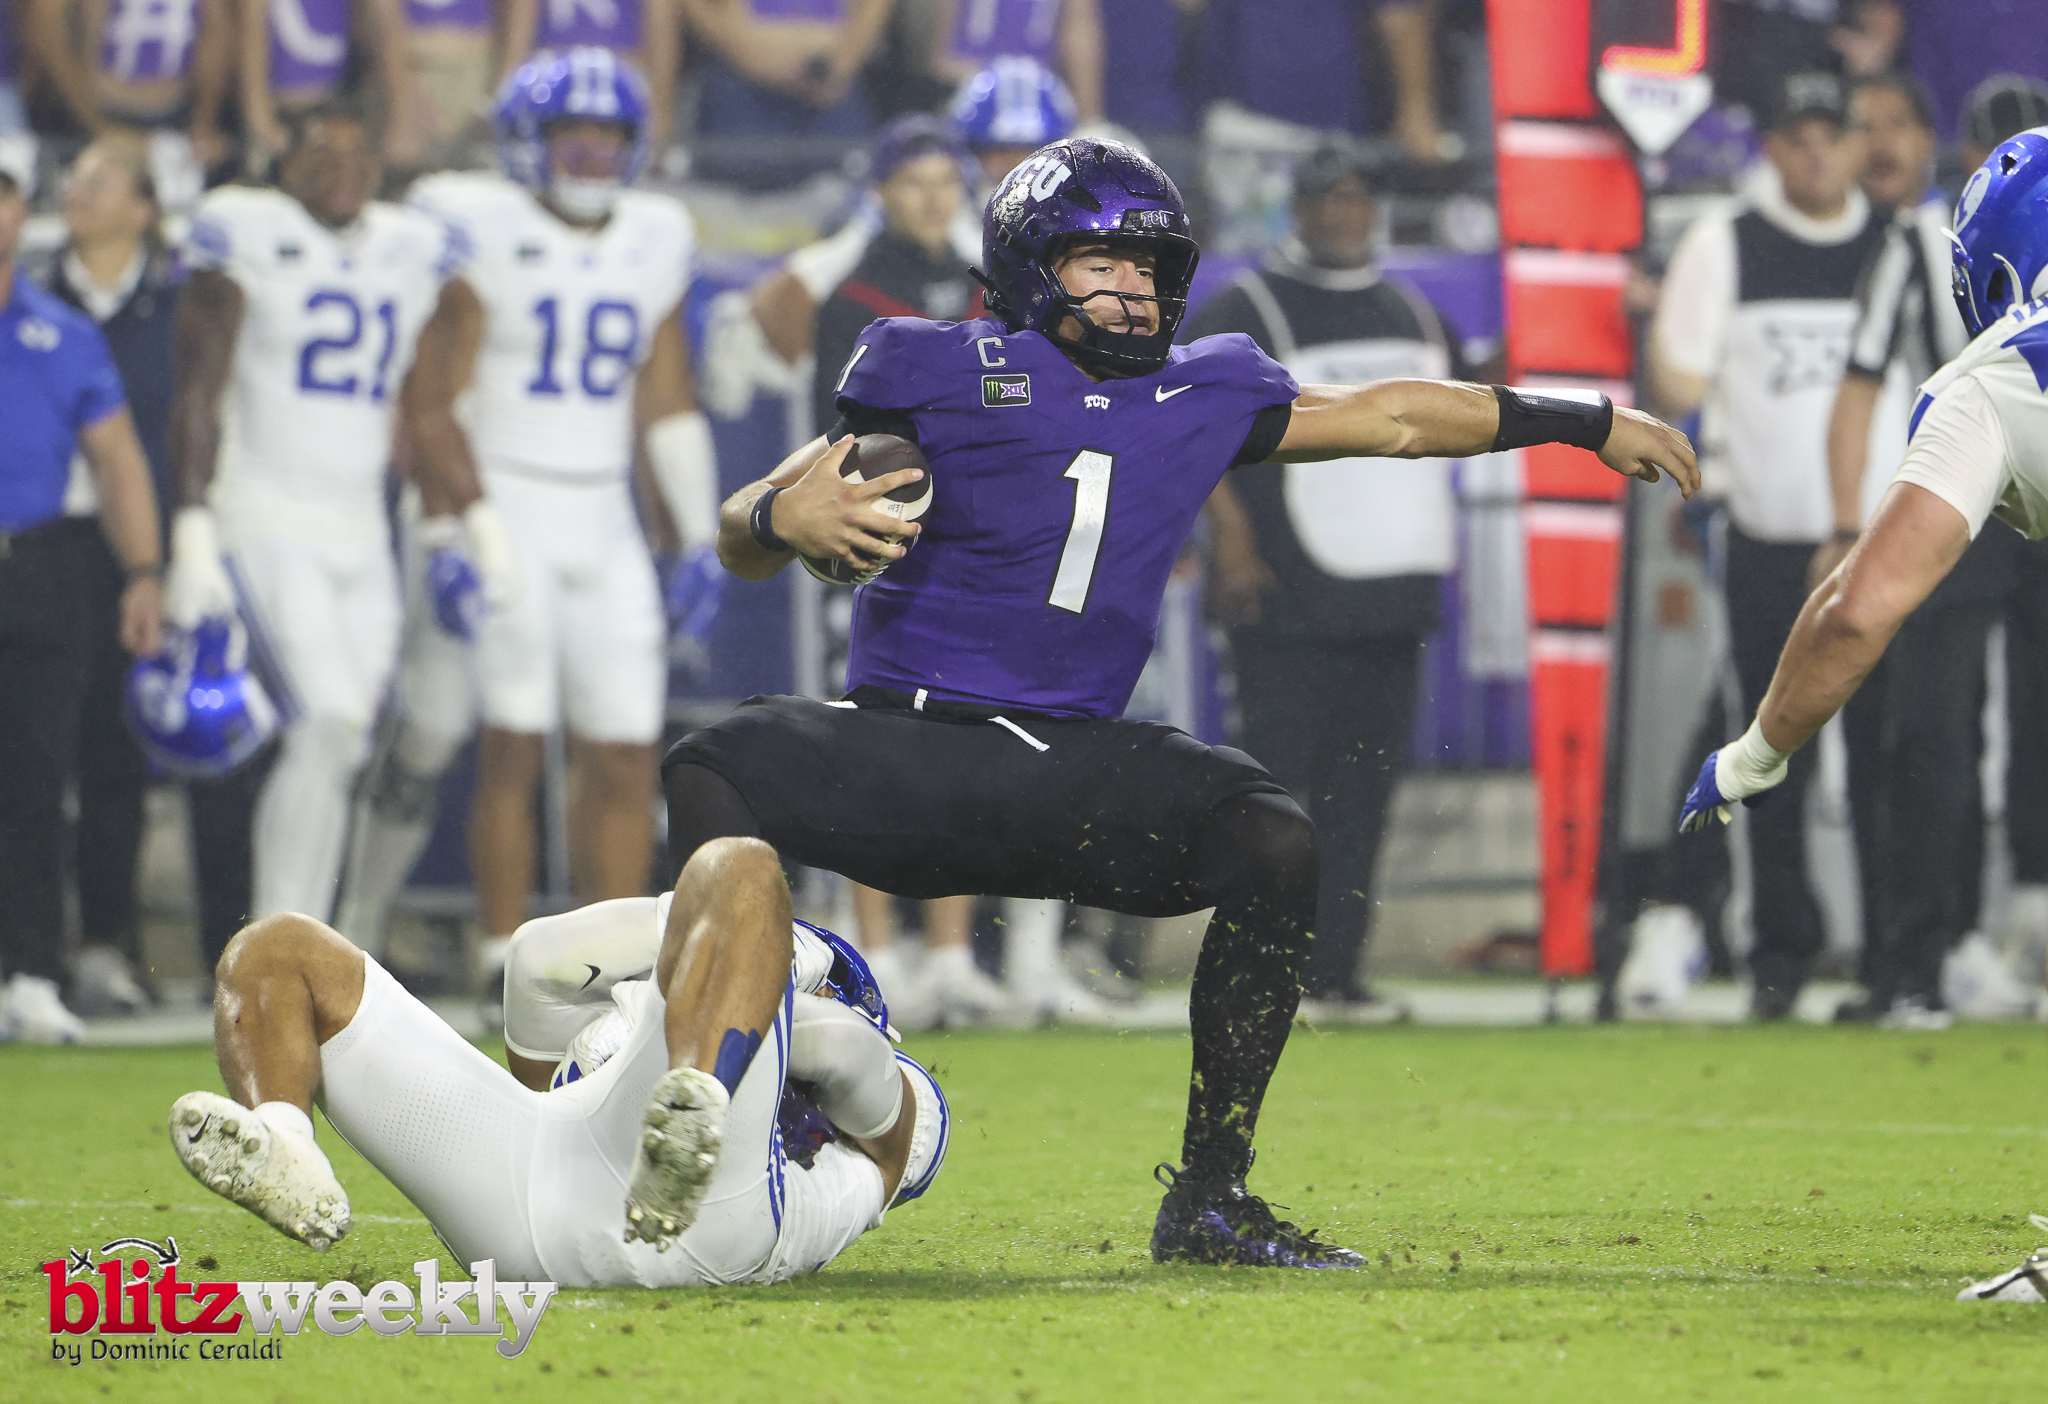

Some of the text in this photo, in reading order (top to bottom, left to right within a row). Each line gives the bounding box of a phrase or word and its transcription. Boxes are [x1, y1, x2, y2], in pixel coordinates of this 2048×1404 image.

[992, 157, 1072, 202] TCU
[1140, 210, 1173, 228] TCU
[297, 290, 396, 400] 21
[527, 297, 641, 398] 18
[976, 336, 1007, 368] C
[1084, 394, 1111, 410] TCU
[1046, 447, 1116, 618] 1
